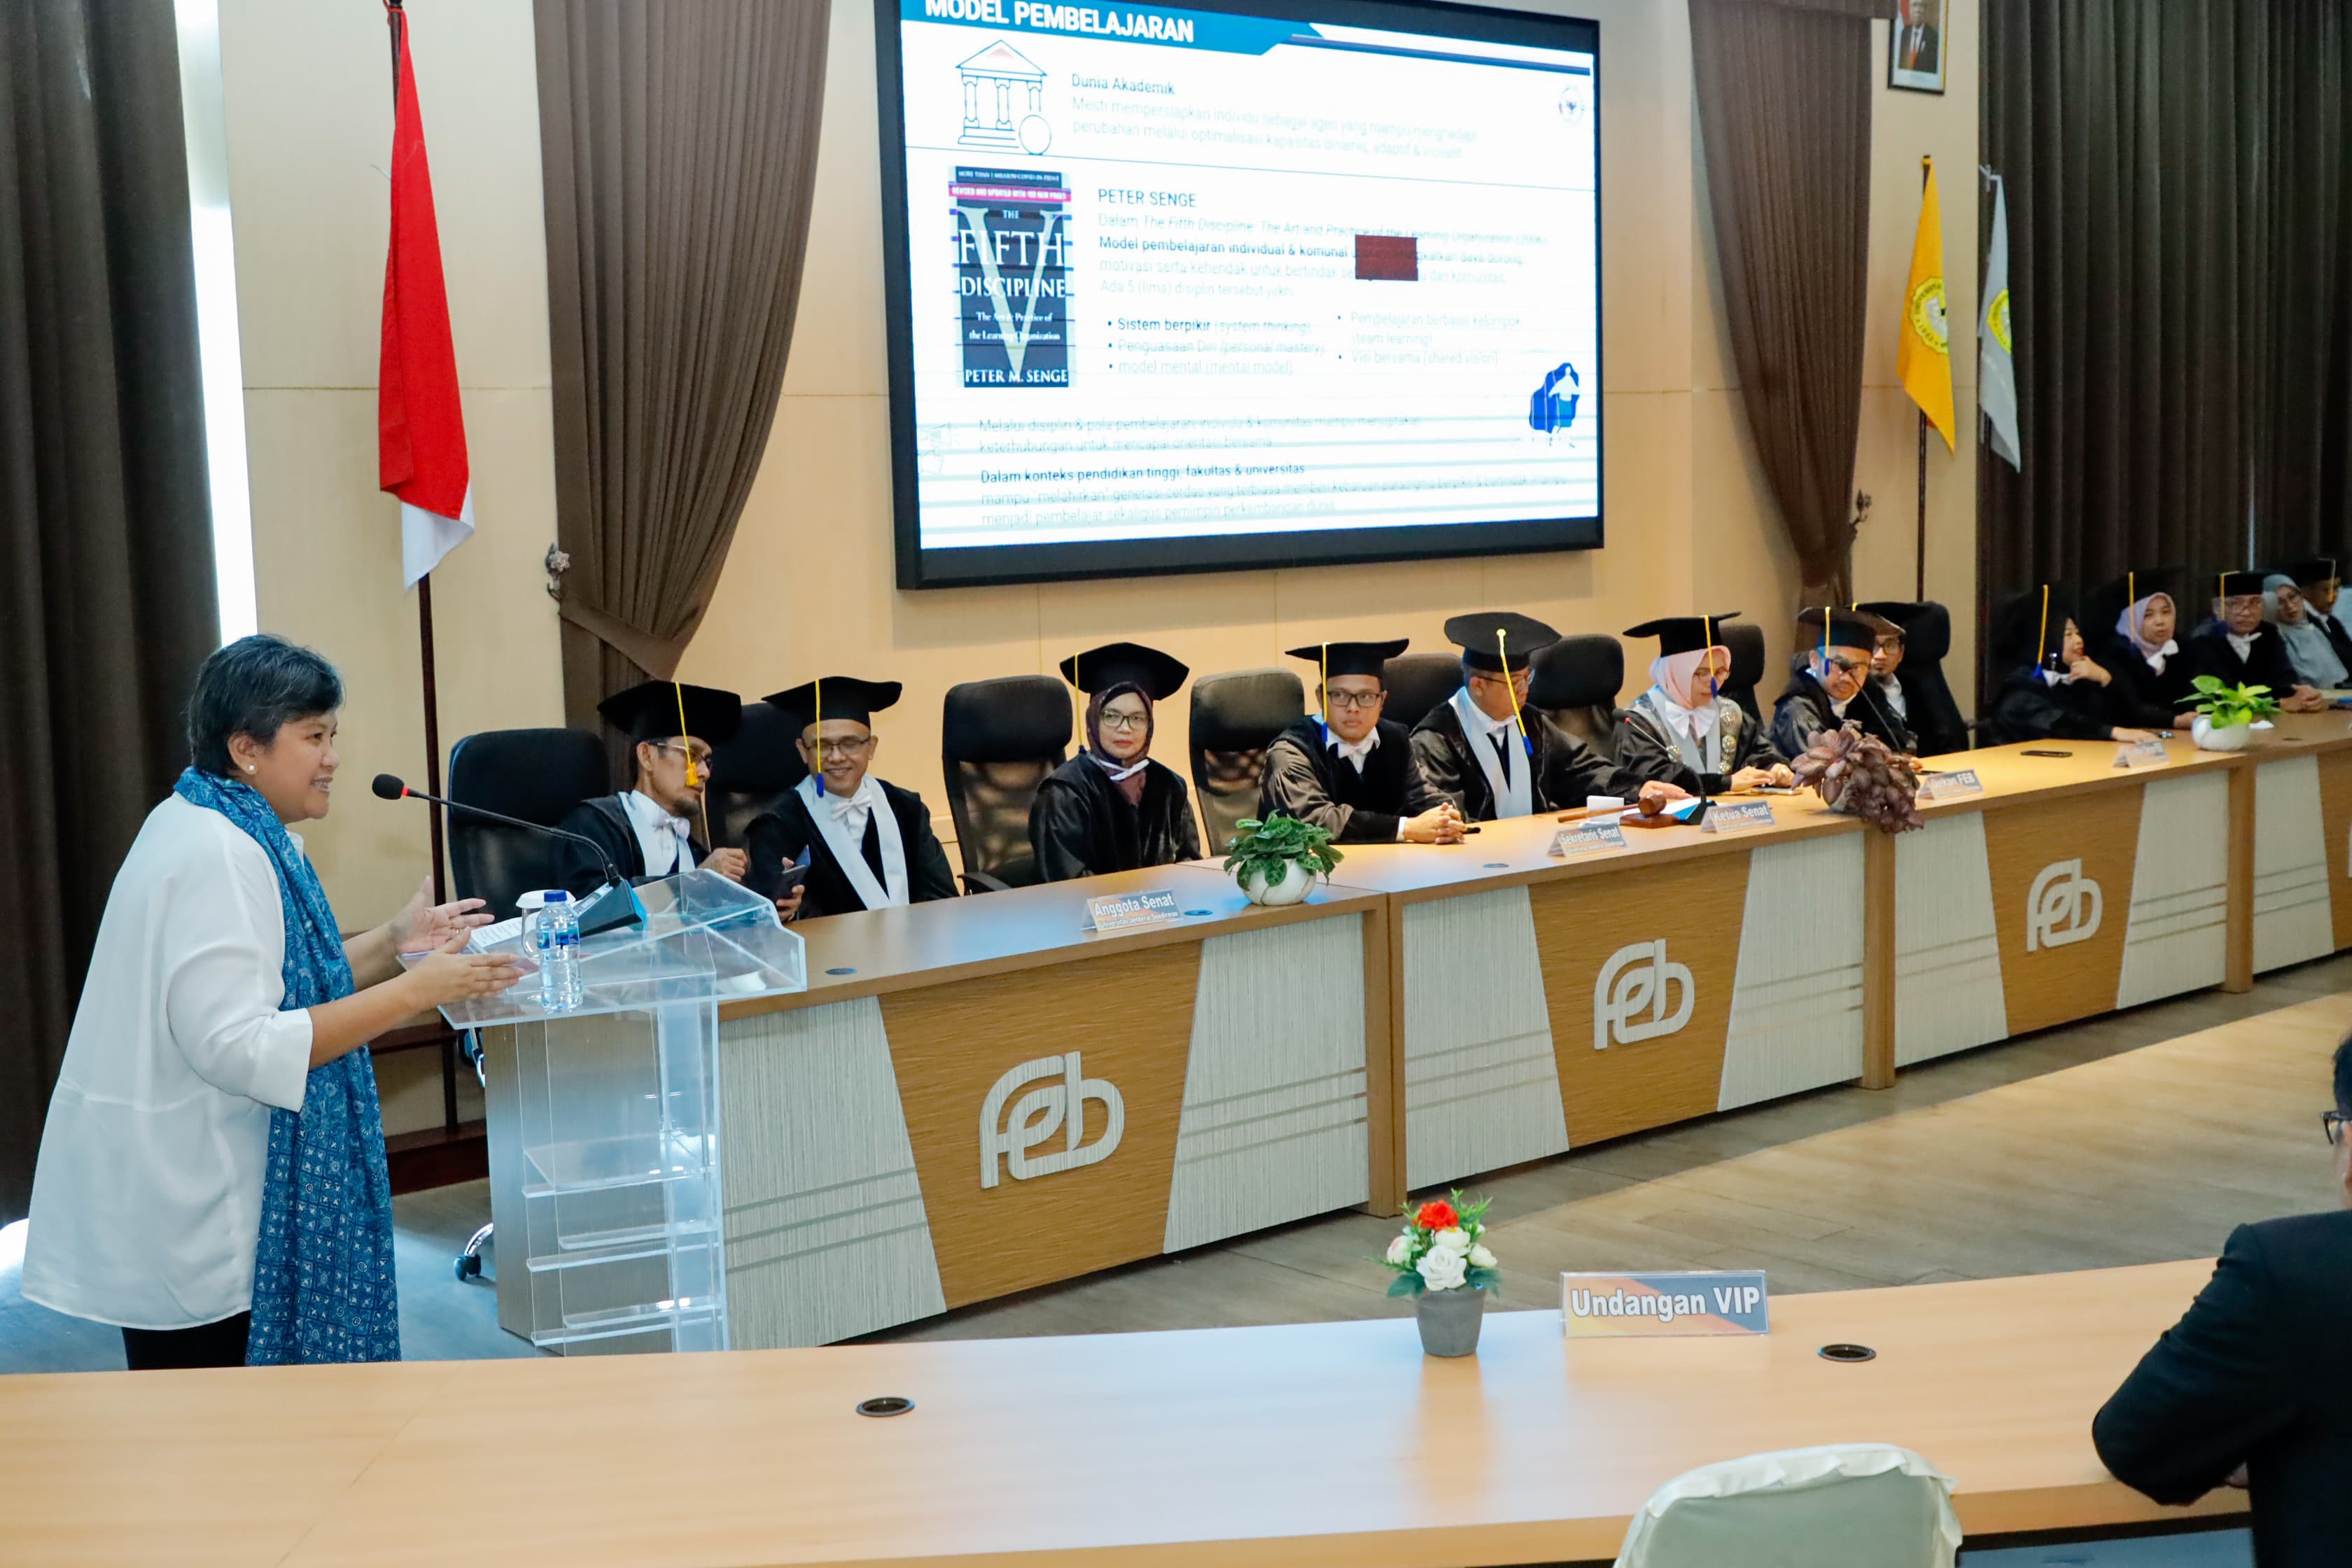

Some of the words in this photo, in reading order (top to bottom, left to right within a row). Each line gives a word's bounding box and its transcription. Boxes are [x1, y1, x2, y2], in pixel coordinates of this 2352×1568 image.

[925, 0, 1009, 24] MODEL
[1014, 0, 1195, 43] PEMBELAJARAN
[1071, 73, 1109, 90] Dunia
[1112, 77, 1175, 95] Akademik
[1072, 120, 1140, 135] perubahan
[1098, 188, 1144, 205] PETER
[1149, 191, 1197, 207] SENGE
[1002, 209, 1019, 218] THE
[959, 229, 1065, 267] FIFTH
[1099, 236, 1139, 250] Model
[1142, 237, 1225, 255] pembelajaran
[1228, 241, 1284, 255] individual
[1288, 243, 1296, 255] &
[1300, 244, 1348, 258] komunal
[961, 277, 1066, 298] DISCIPLINE
[1118, 318, 1161, 331] Sistem
[1164, 319, 1210, 334] berpikir
[965, 369, 1005, 383] PETER
[1008, 369, 1023, 383] M.
[1026, 369, 1068, 383] SENGE
[981, 470, 1022, 484] Dalam
[1024, 467, 1073, 482] konteks
[1077, 465, 1143, 484] pendidikan
[1186, 463, 1231, 477] fakultas
[1234, 462, 1242, 476] &
[1245, 463, 1306, 477] universitas
[1956, 771, 1975, 785] FEB
[1713, 810, 1742, 822] Ketua
[1741, 804, 1769, 818] Senat
[1561, 829, 1599, 845] Sekretaris
[1597, 825, 1620, 840] Senat
[1094, 899, 1141, 918] Anggota
[1141, 892, 1175, 909] Senat
[1571, 1287, 1707, 1323] Undangan
[1712, 1285, 1760, 1315] VIP
